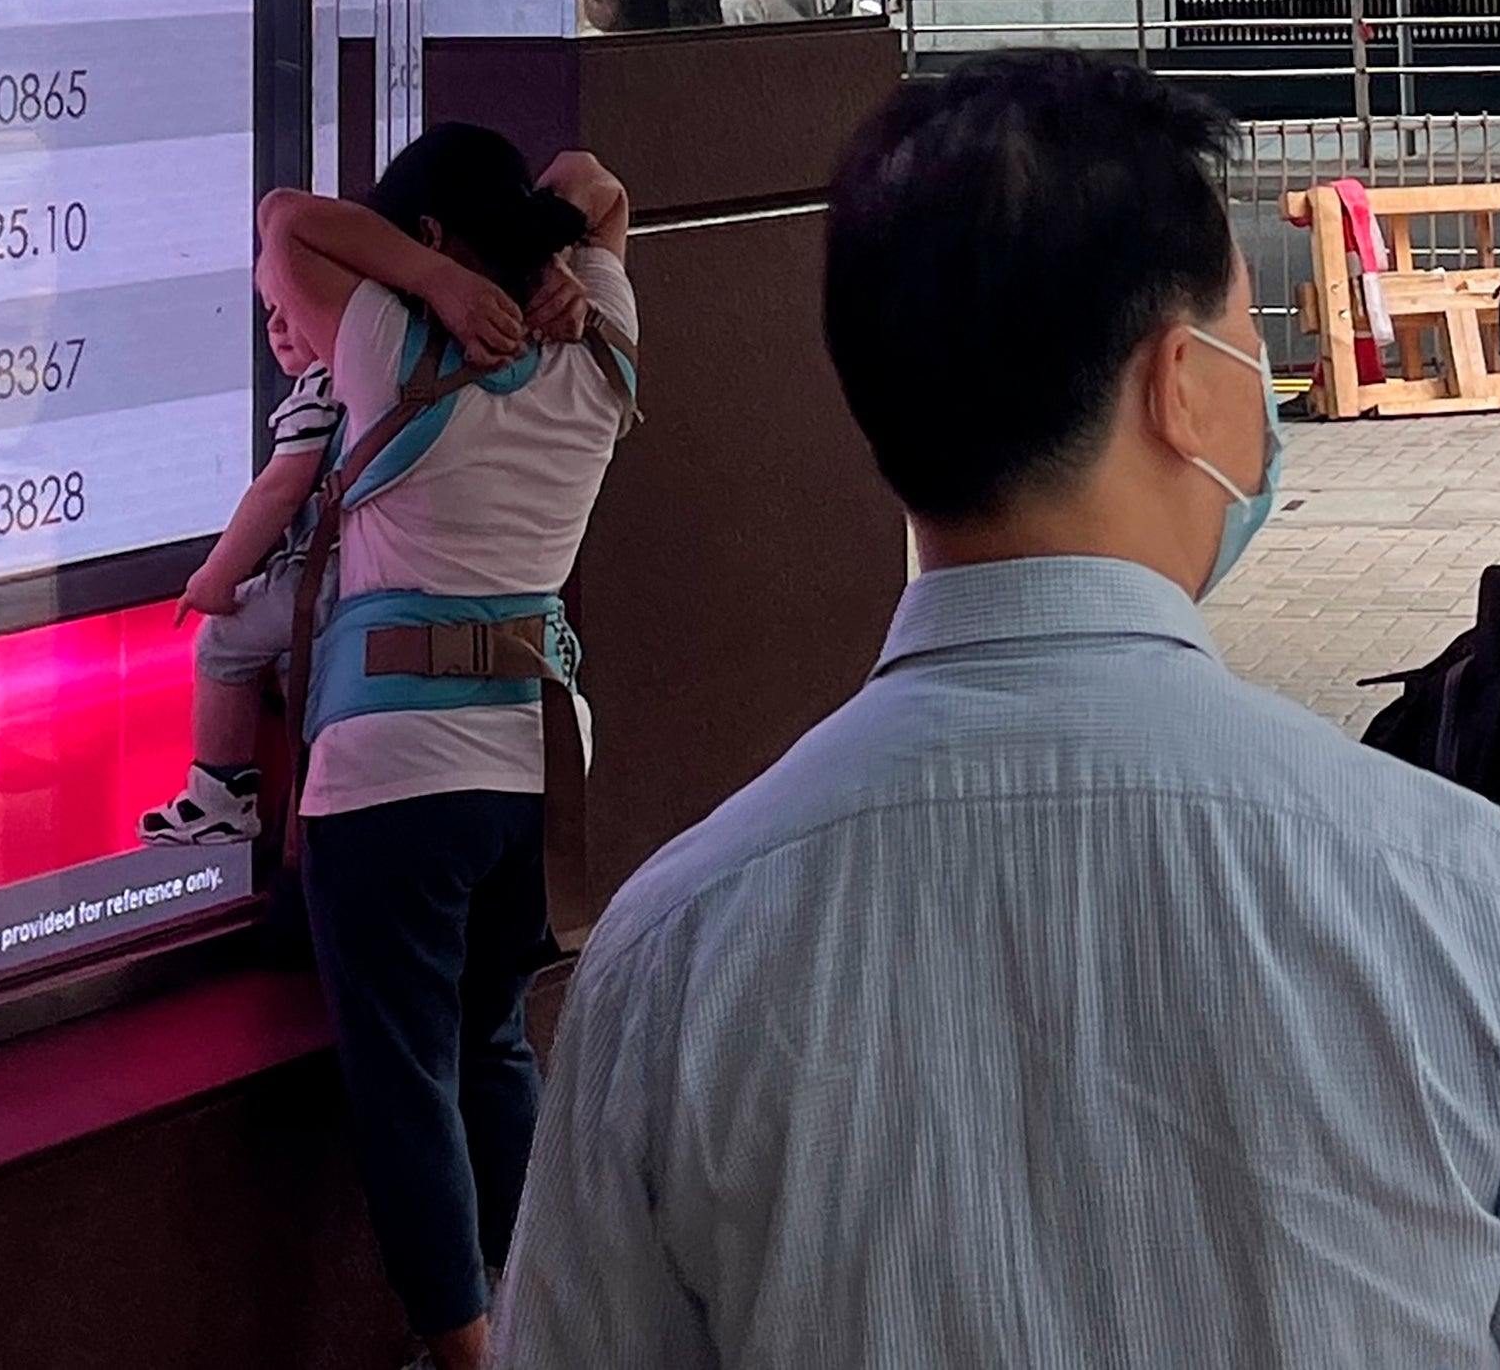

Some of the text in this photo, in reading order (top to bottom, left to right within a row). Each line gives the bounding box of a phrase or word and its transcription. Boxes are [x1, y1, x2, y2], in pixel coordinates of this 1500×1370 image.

[1, 903, 75, 953] provided
[79, 898, 102, 924] for
[105, 878, 183, 920] reference
[187, 864, 223, 895] only.
